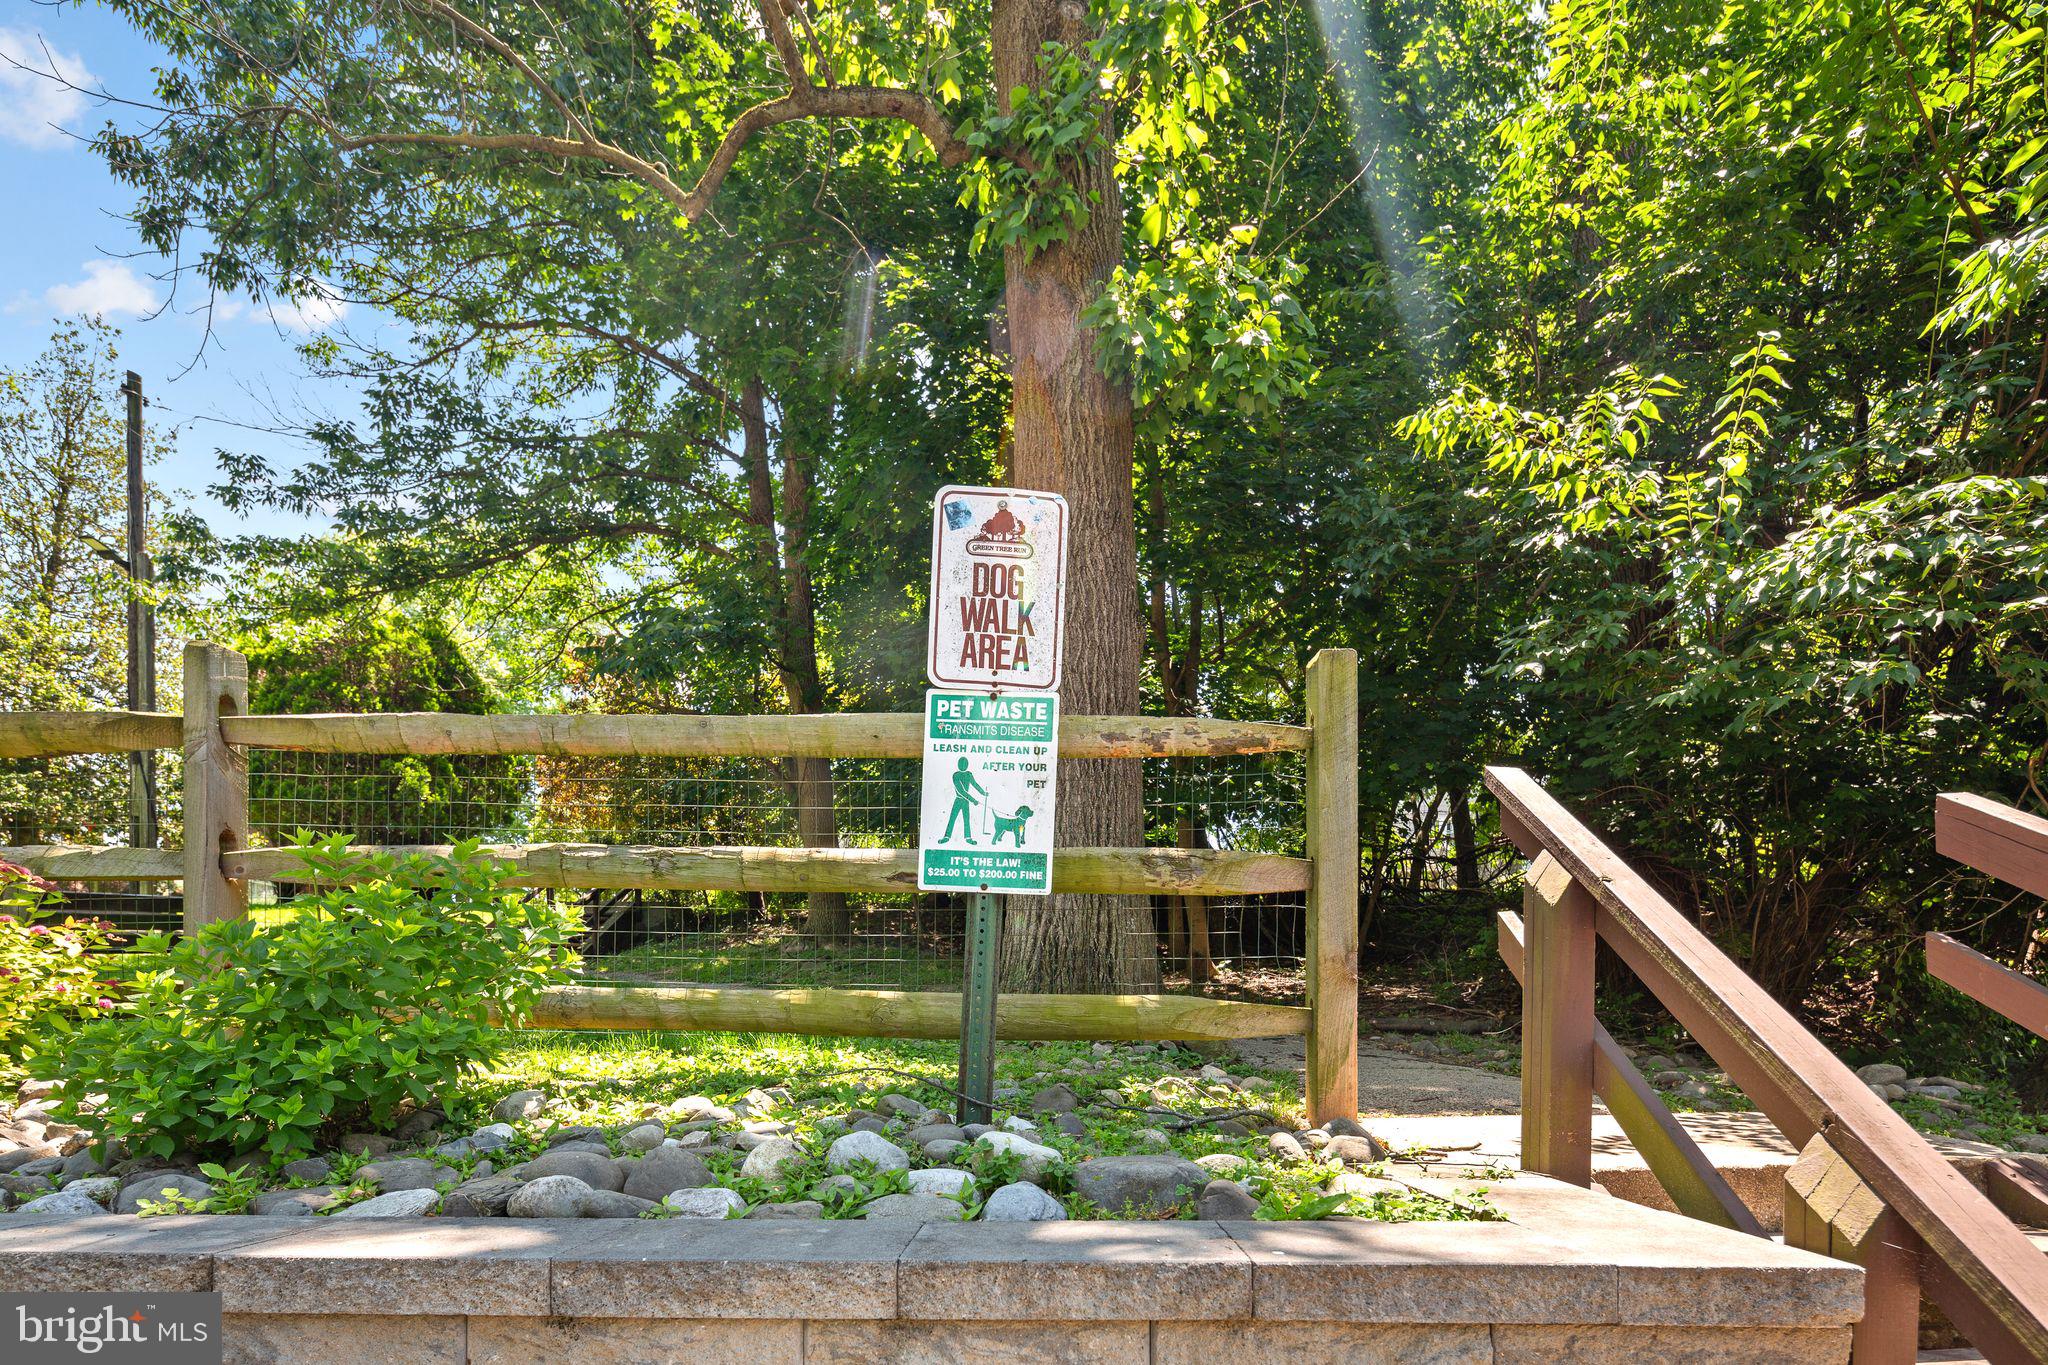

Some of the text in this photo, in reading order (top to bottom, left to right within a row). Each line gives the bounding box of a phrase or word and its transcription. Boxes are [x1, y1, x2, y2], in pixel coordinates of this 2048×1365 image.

[972, 562, 1025, 600] DOG
[959, 596, 1035, 637] WALK
[959, 632, 1030, 672] AREA
[937, 699, 1048, 720] PET WASTE
[938, 724, 1045, 737] TRANSMITS DISEASE
[933, 743, 1048, 755] LEASH AND CLEAN UP
[982, 761, 1047, 772] AFTER YOUR
[1026, 779, 1047, 789] PET
[950, 856, 1021, 868] IT'S THE LAW!
[927, 867, 1043, 880] $25.00 TO $200.00 FINE
